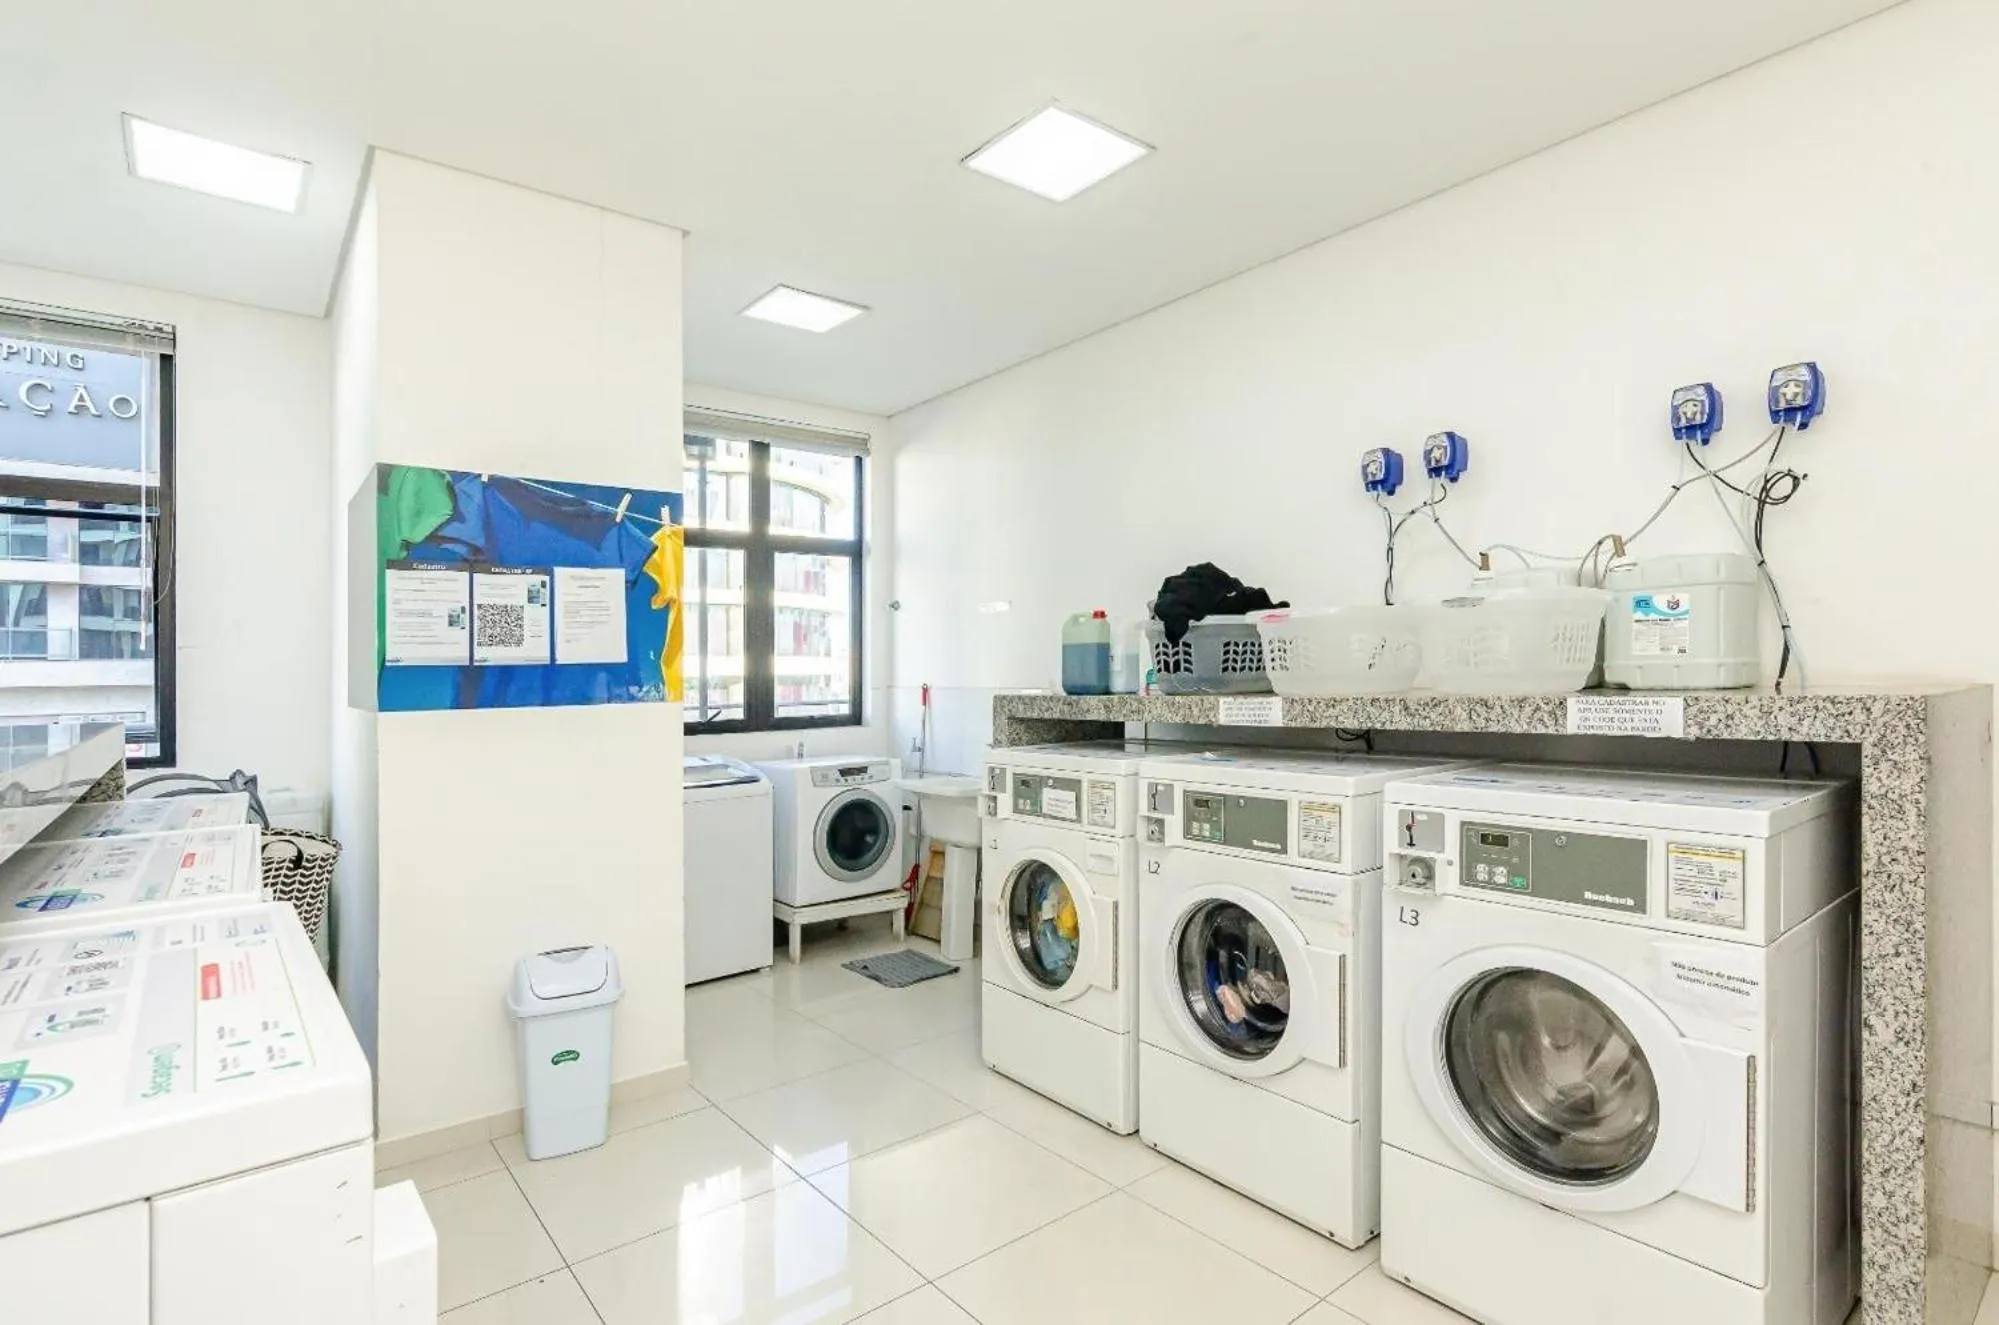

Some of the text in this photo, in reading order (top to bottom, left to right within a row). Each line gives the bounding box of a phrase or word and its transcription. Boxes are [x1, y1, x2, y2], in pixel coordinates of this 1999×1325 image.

[0, 342, 85, 371] PING
[0, 379, 138, 419] ÇÃO
[1148, 859, 1161, 876] L2
[1399, 905, 1419, 926] L3
